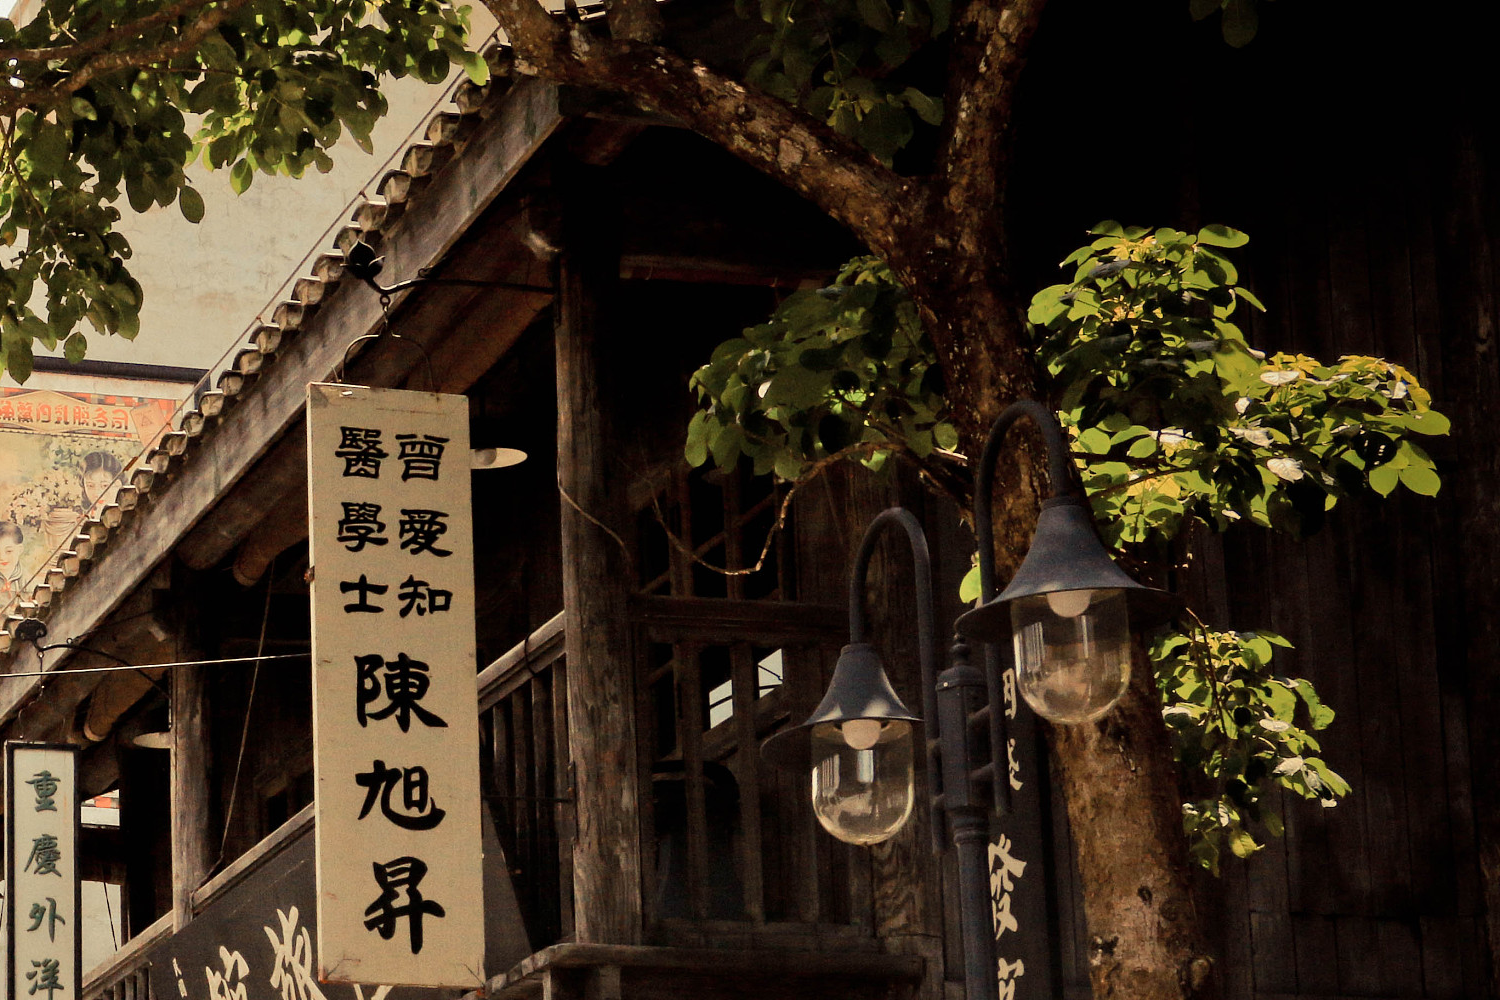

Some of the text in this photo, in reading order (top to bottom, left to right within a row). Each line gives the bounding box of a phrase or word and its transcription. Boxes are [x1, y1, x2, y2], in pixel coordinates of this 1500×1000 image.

[334, 426, 389, 614] 醫學士
[354, 652, 450, 956] 陳旭昇
